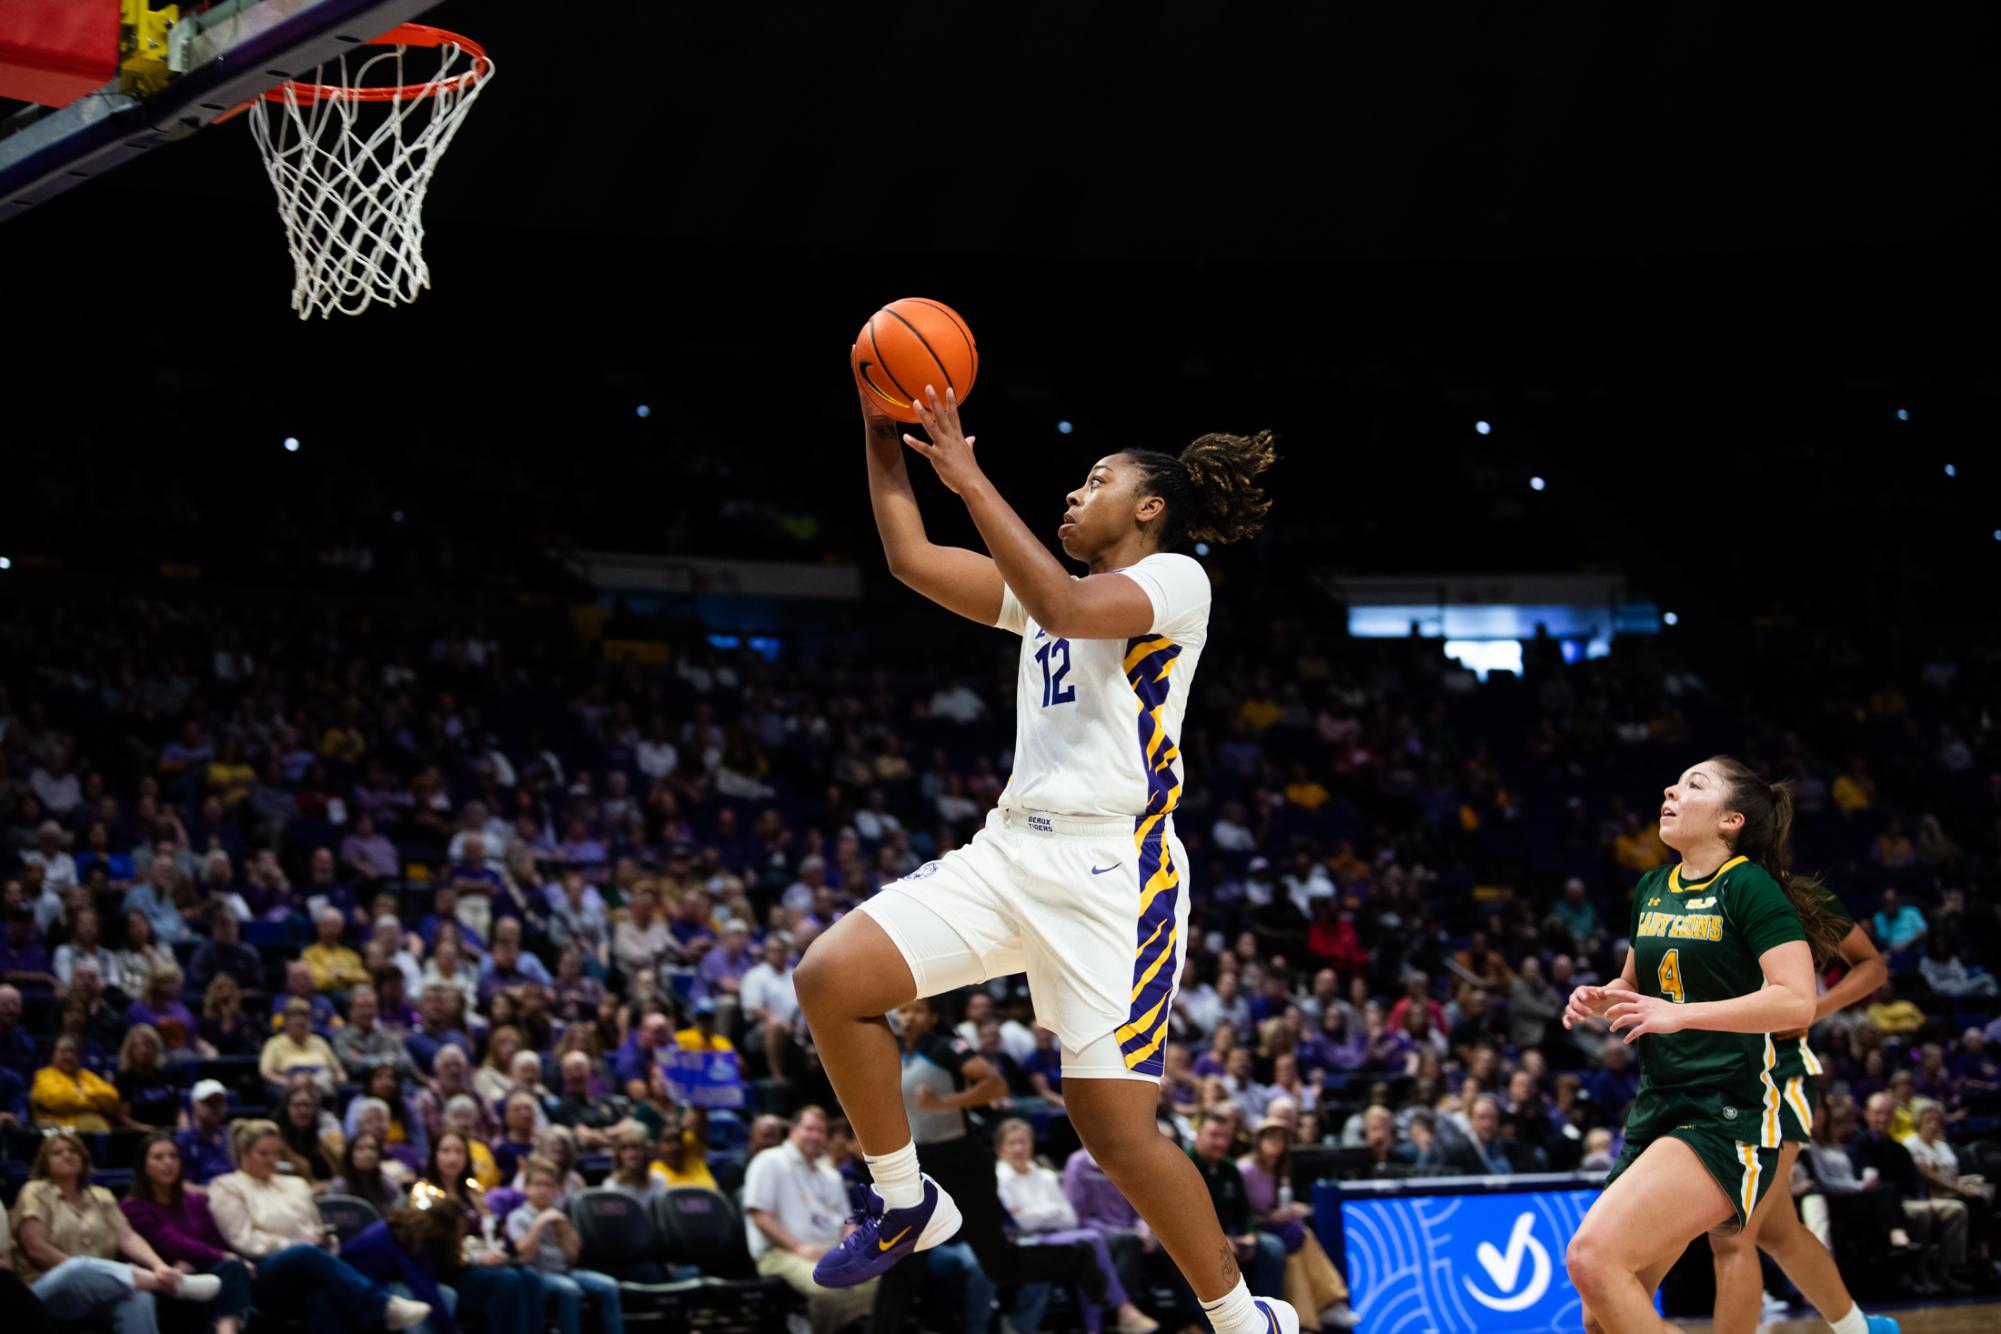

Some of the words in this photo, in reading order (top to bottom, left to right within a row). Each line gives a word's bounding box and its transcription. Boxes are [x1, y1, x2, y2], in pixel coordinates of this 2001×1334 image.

[1035, 638, 1075, 707] 12
[1028, 823, 1053, 832] TIGERS
[1637, 911, 1675, 937] LADY
[1668, 913, 1723, 941] LIONS
[1658, 948, 1684, 1003] 4
